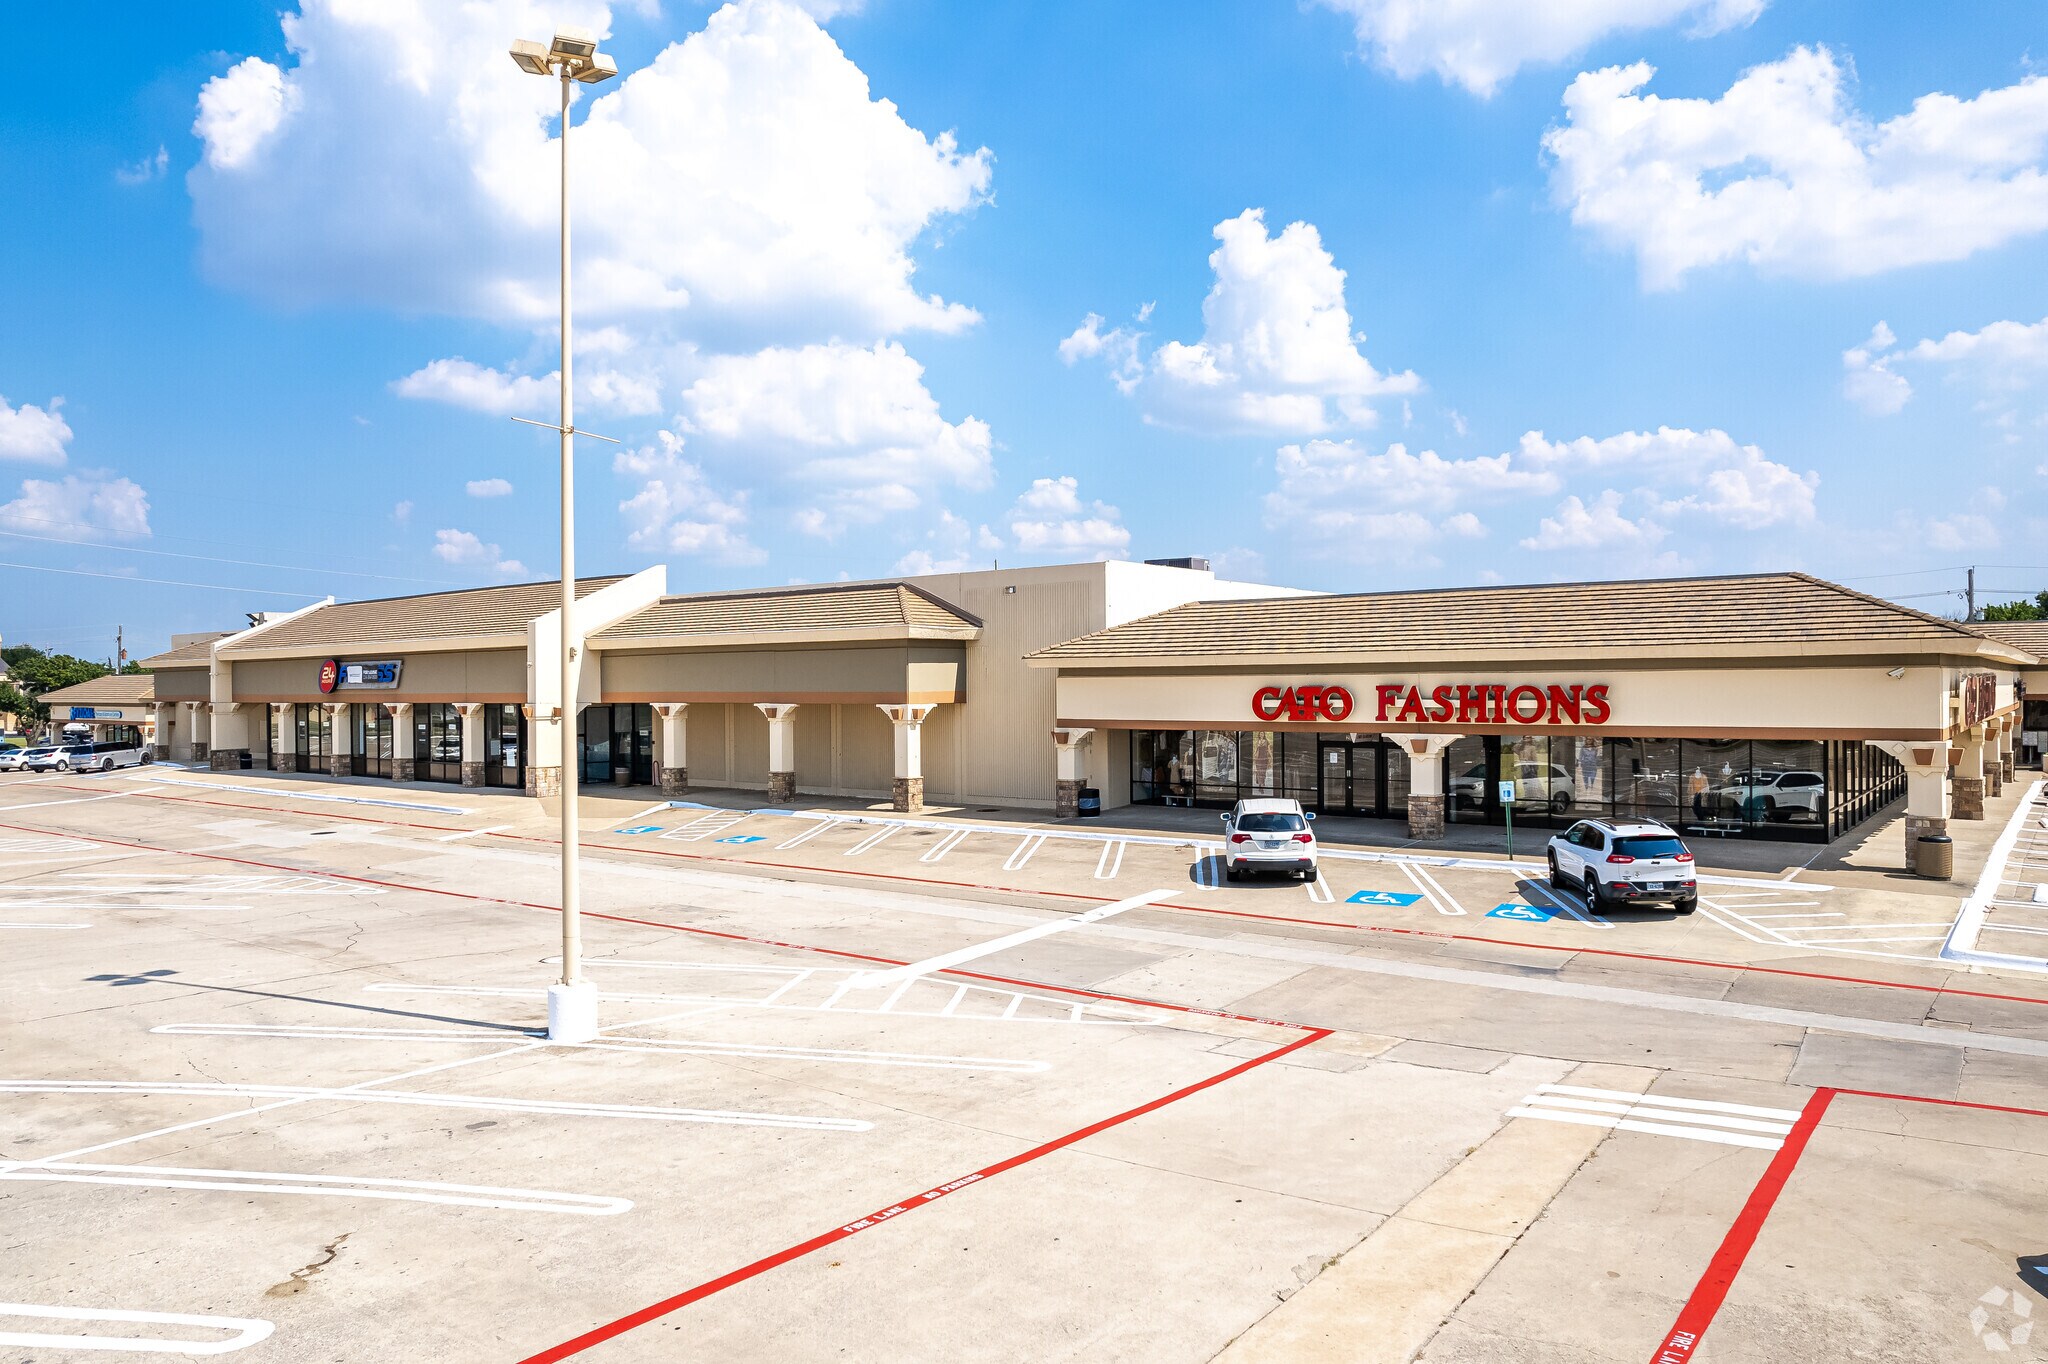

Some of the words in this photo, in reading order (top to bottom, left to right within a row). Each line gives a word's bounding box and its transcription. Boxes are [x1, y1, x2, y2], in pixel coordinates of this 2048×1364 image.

[322, 667, 335, 683] 24
[1252, 685, 1355, 722] CATO
[1375, 685, 1613, 726] FASHIONS
[843, 1218, 875, 1234] FIRE
[873, 1205, 907, 1221] LANE
[921, 1191, 942, 1200] NO
[939, 1173, 985, 1192] PARKING
[1668, 1330, 1696, 1351] FIRE
